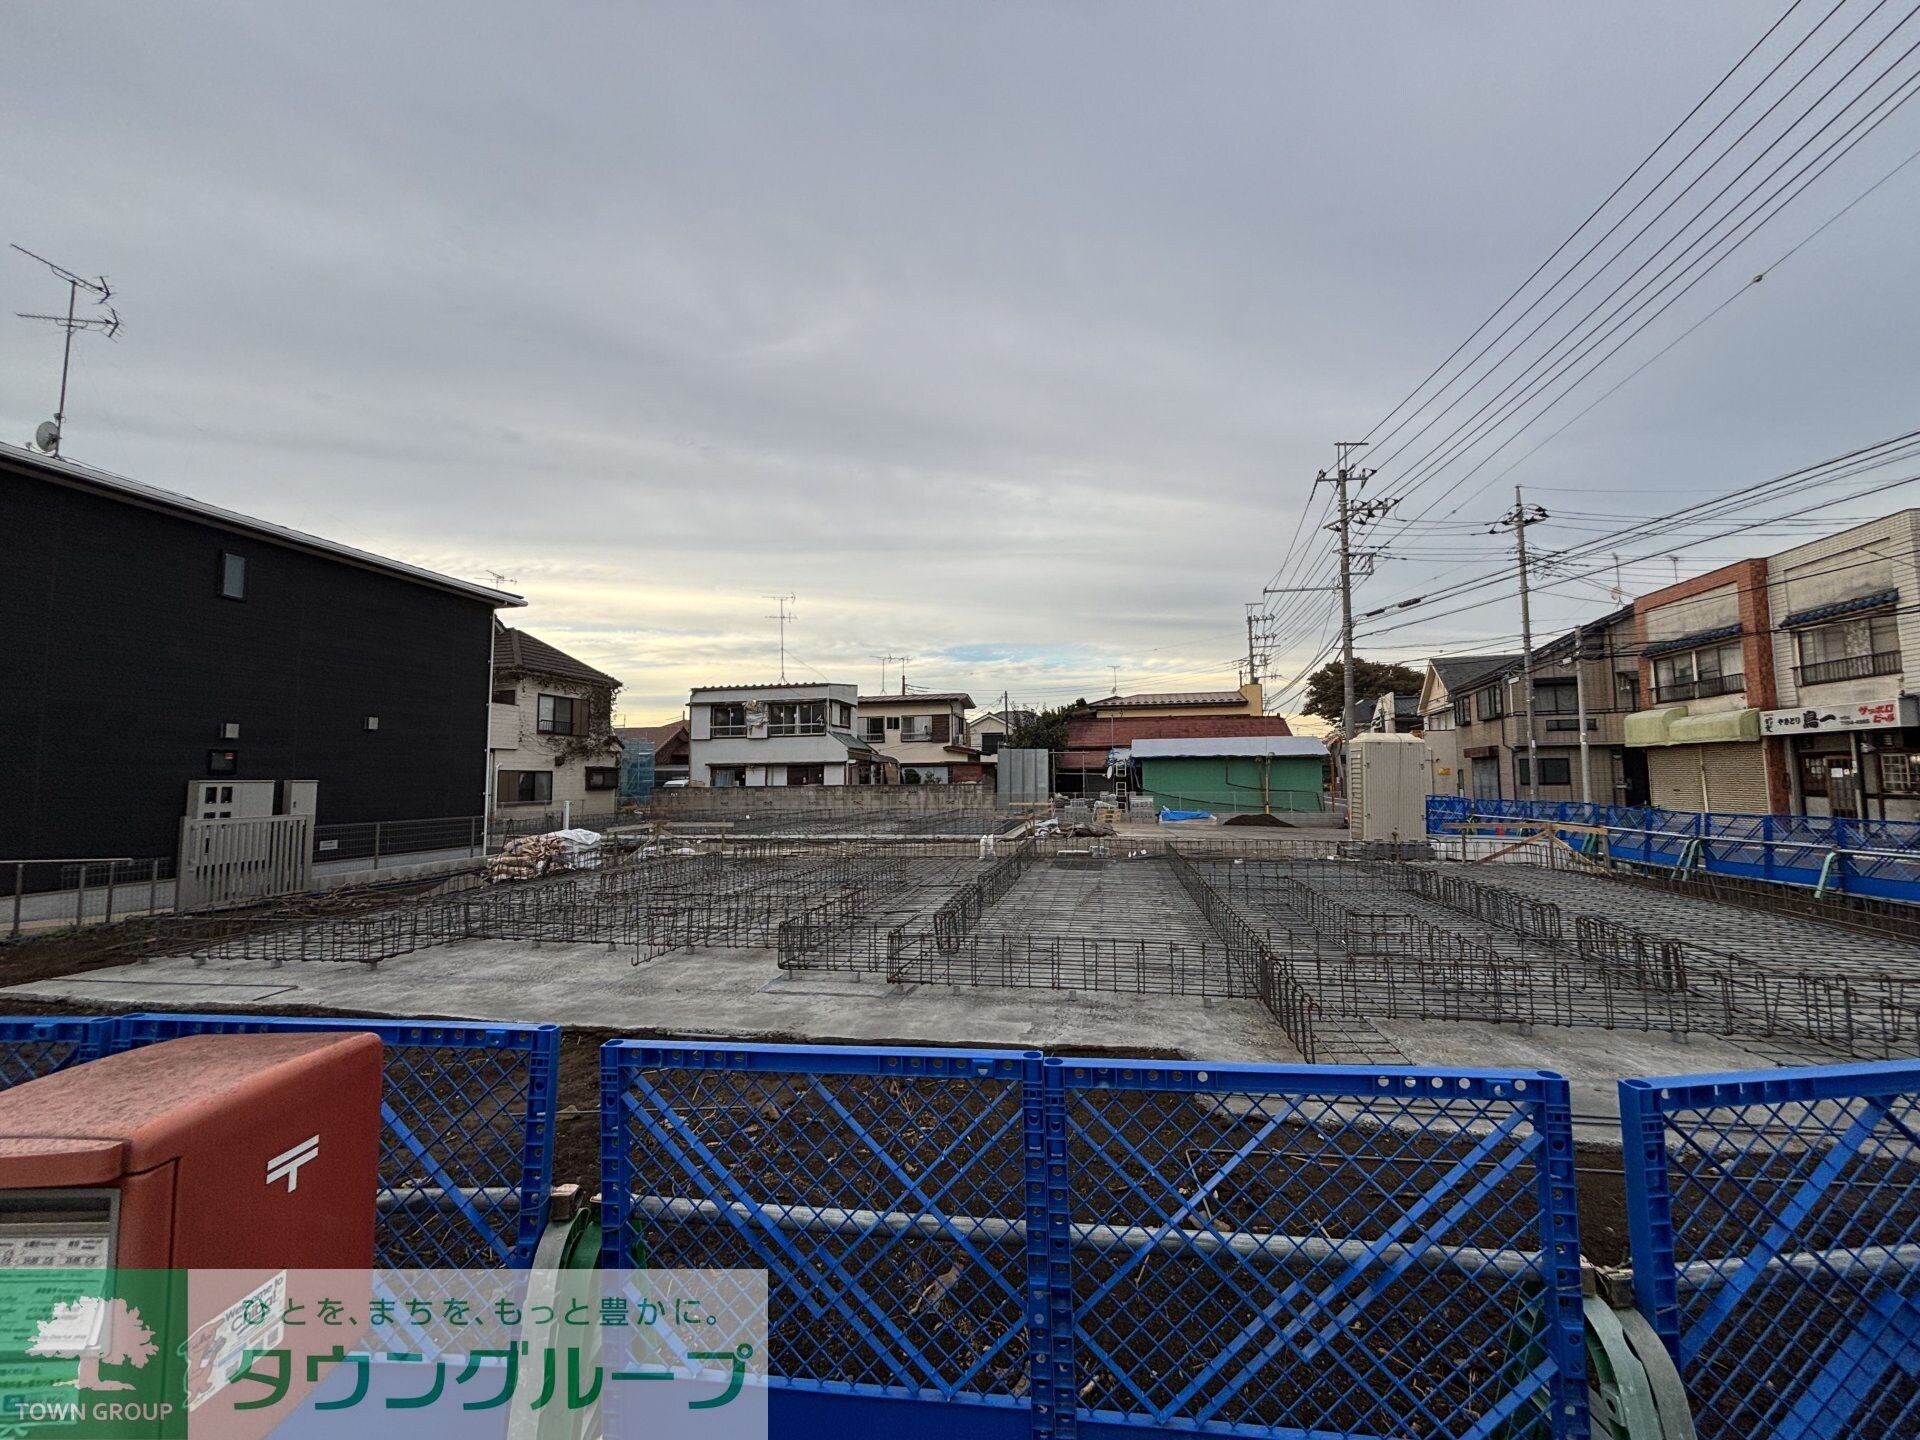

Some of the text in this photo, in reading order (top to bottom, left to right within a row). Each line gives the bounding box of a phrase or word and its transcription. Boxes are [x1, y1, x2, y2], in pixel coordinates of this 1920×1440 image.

[1859, 704, 1894, 716] サッポロ
[1777, 716, 1801, 726] やきとり
[1802, 710, 1836, 730] 鳥一
[1873, 713, 1895, 724] ビール
